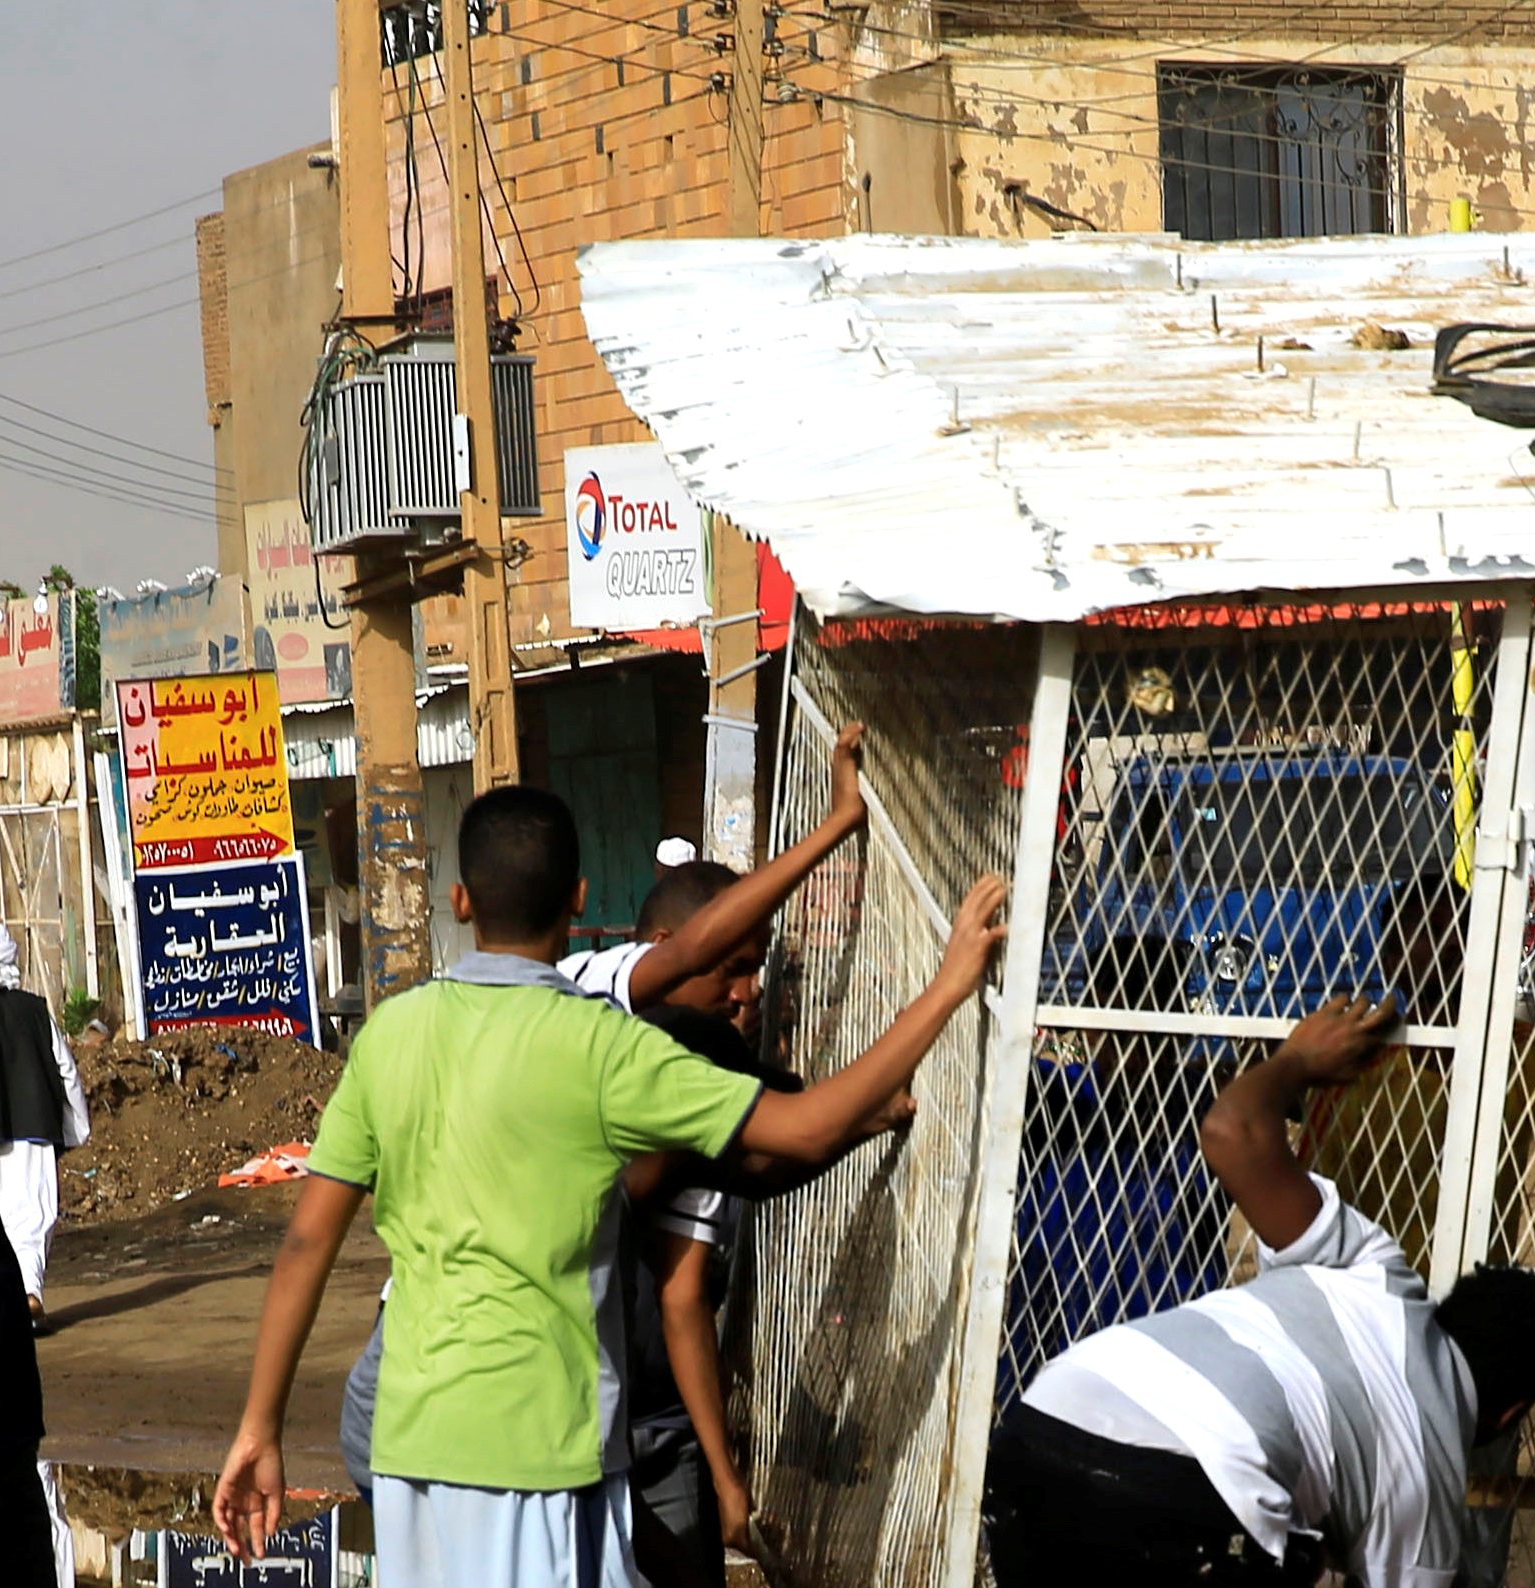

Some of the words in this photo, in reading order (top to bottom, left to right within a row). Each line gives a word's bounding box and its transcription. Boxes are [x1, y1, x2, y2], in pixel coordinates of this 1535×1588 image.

[608, 495, 677, 534] TOTAL
[607, 548, 697, 600] QUARTZ
[125, 680, 215, 727] سفيان
[217, 671, 258, 726] أبو
[127, 724, 277, 787] للمناسبات
[148, 880, 254, 917] سفيان
[258, 863, 287, 910] أبو
[164, 911, 285, 959] العقارية
